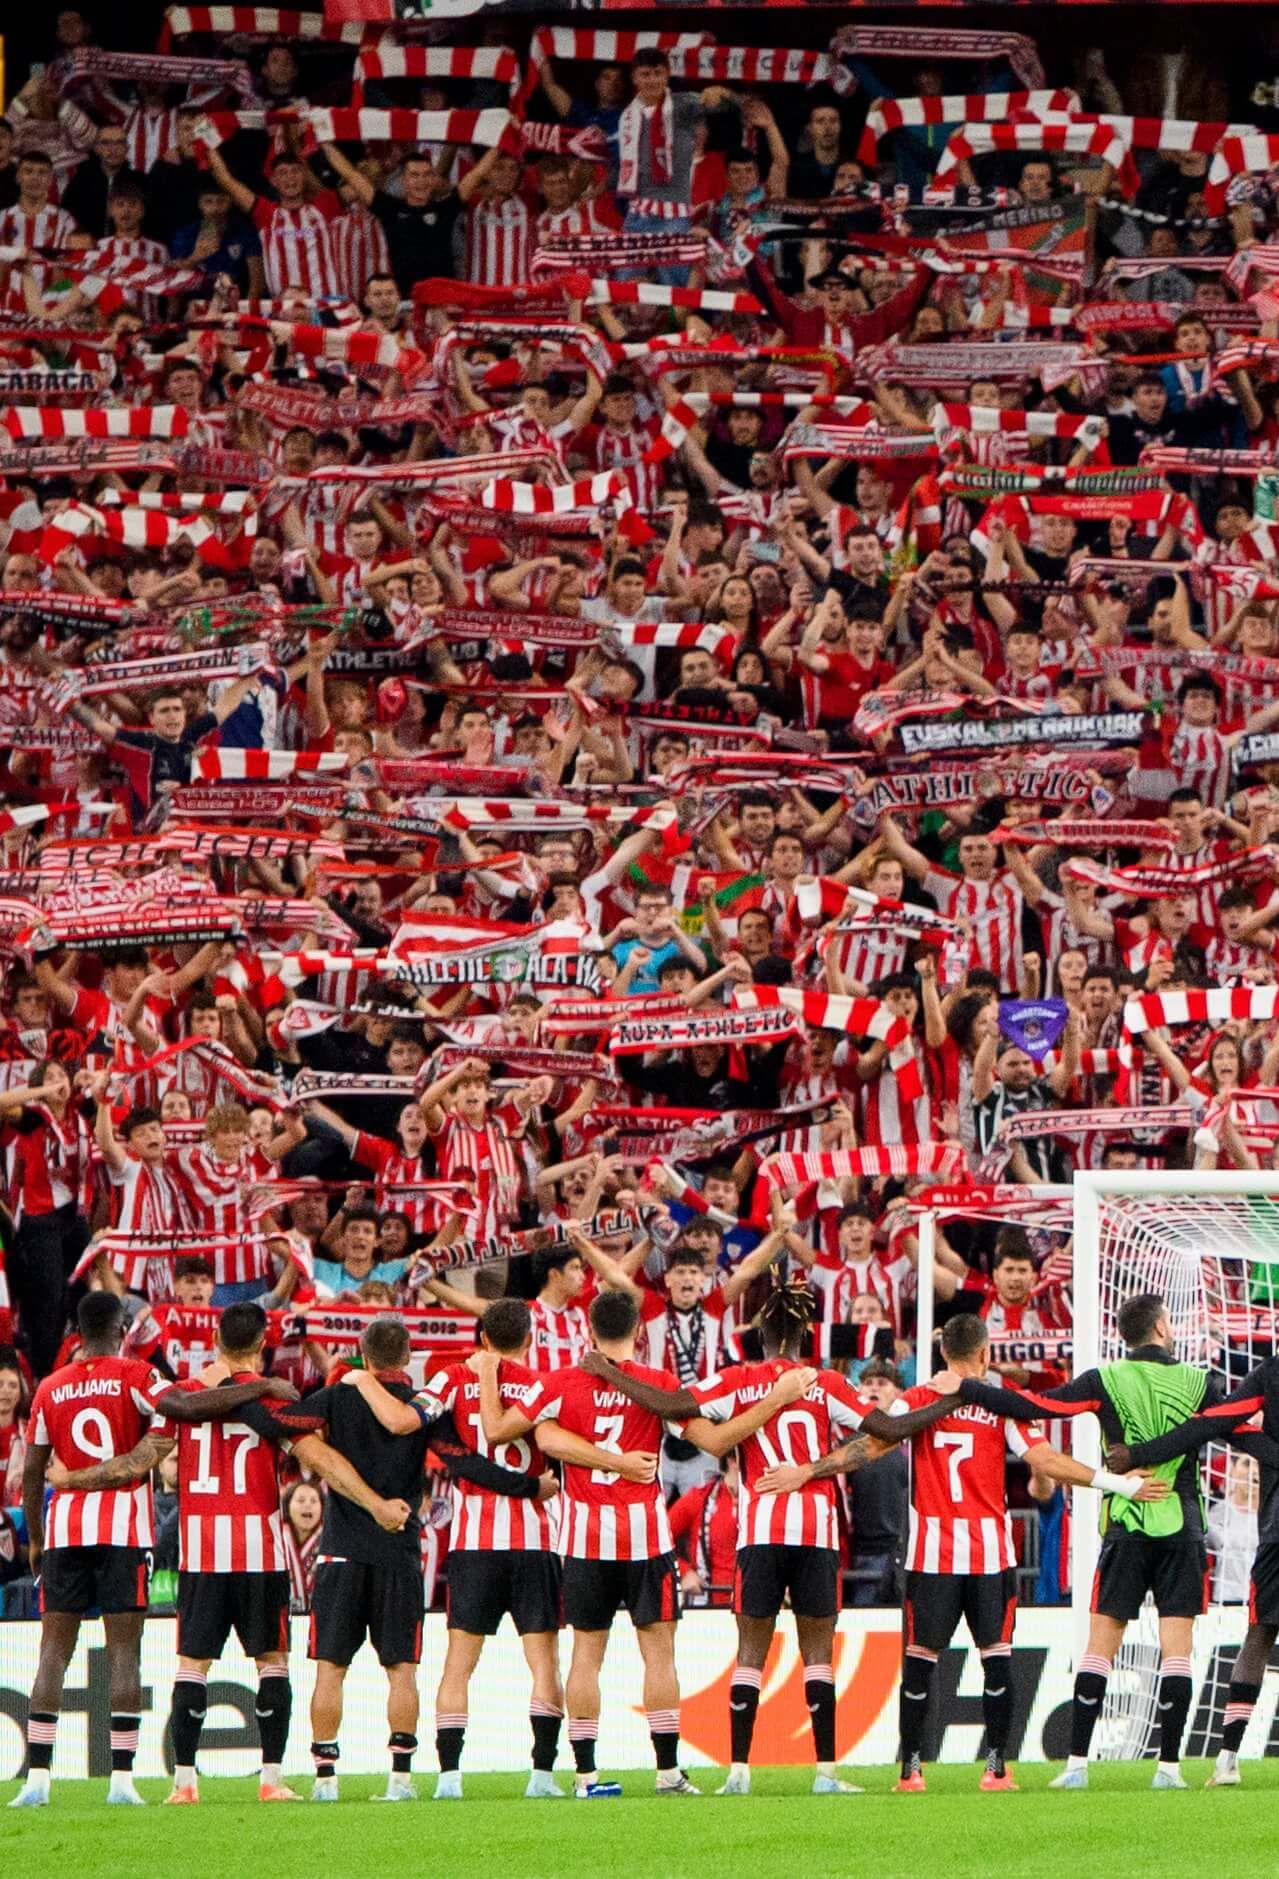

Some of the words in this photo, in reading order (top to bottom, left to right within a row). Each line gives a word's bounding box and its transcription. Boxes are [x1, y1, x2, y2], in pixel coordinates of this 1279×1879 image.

[320, 648, 418, 673] ATHLETIC
[685, 1010, 795, 1040] ATHLETIC
[323, 1316, 362, 1332] 2012
[417, 1319, 458, 1335] 2012
[50, 1378, 122, 1405] WILLIAMS
[71, 1406, 115, 1462] 9
[186, 1420, 261, 1496] 17
[593, 1415, 624, 1486] 3
[754, 1410, 820, 1468] 10
[933, 1432, 974, 1503] 7
